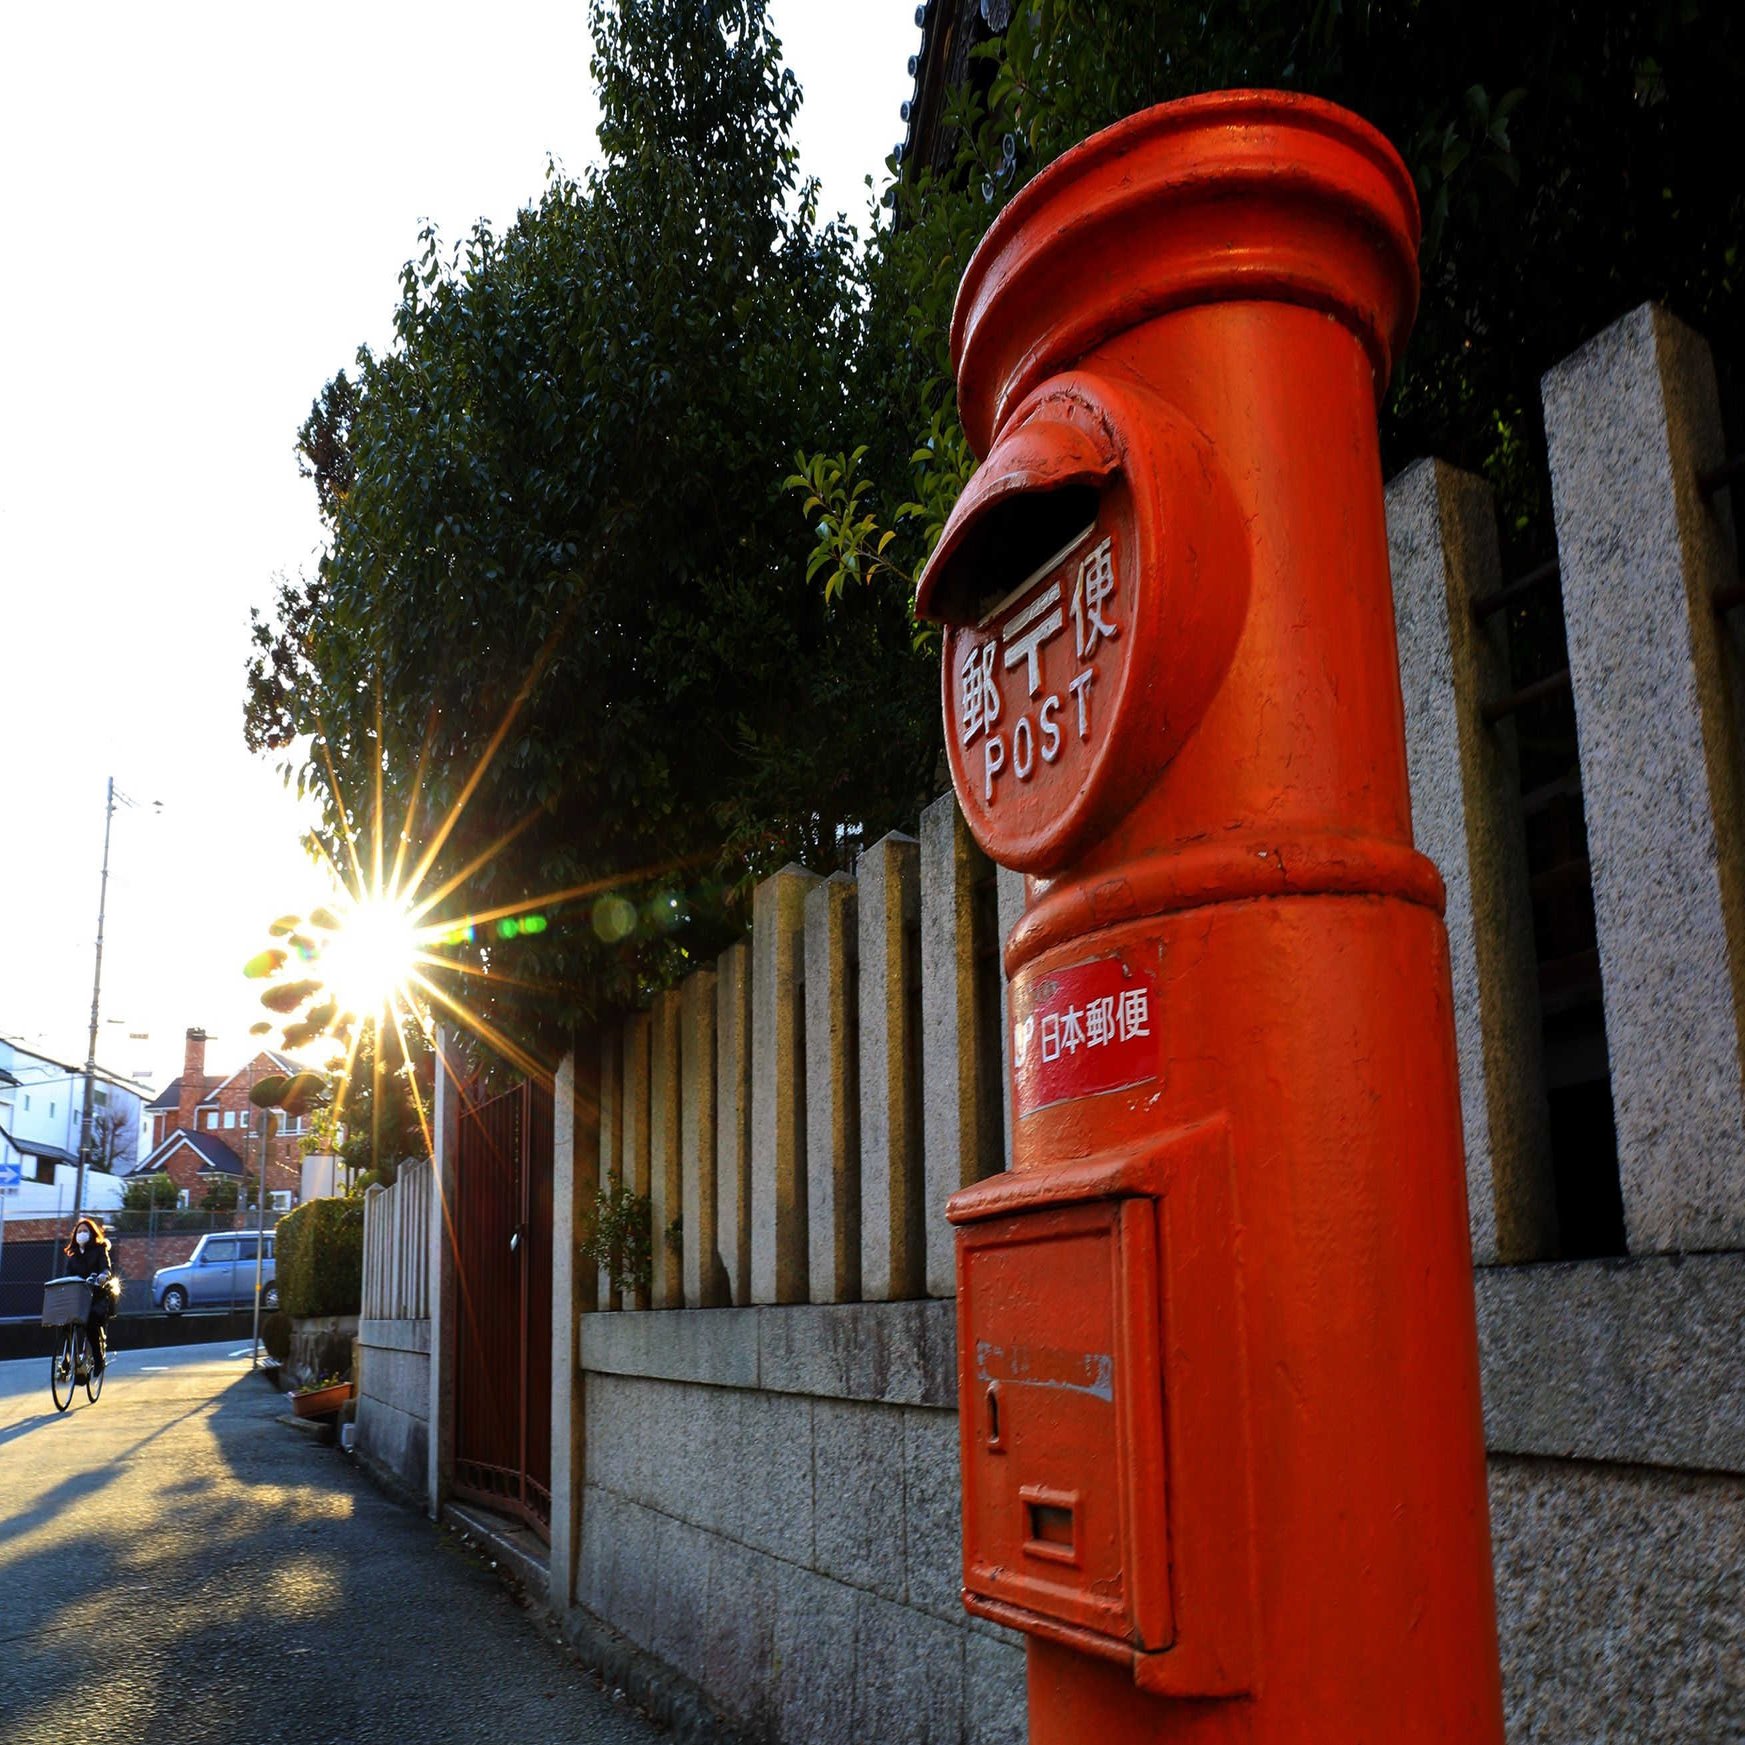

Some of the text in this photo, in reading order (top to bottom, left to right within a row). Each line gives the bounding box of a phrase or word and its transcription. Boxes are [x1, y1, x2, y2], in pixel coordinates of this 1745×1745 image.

[984, 668, 1093, 800] POST
[1041, 988, 1151, 1063] 日本郵便
